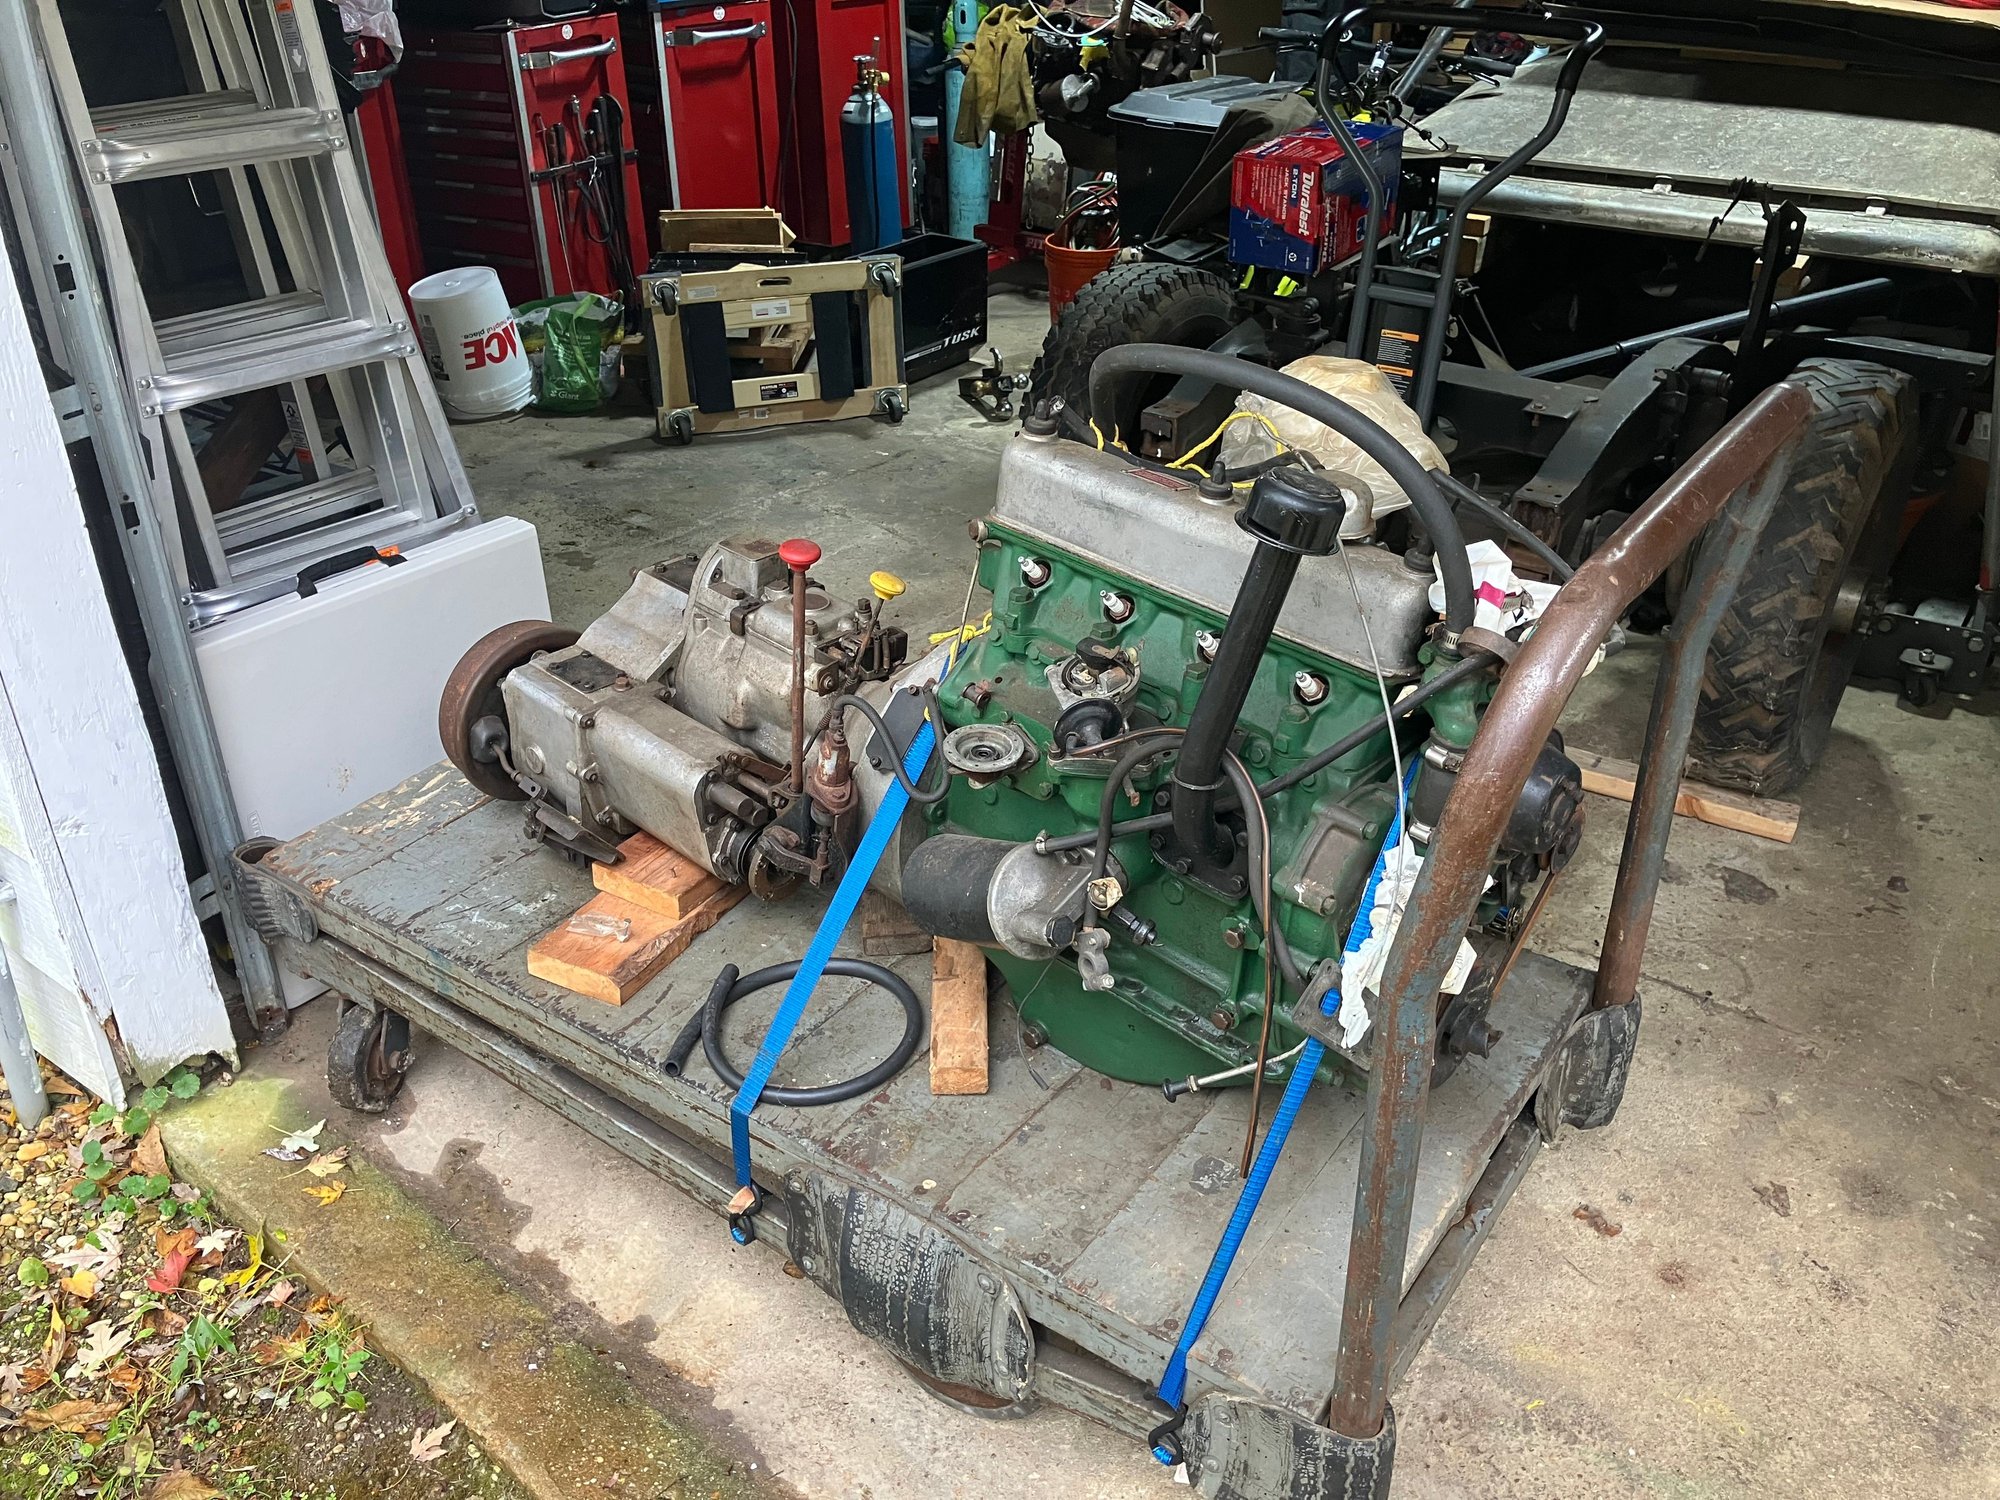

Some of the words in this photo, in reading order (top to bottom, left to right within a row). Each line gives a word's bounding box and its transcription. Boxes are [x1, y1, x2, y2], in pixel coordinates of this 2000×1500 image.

[1298, 171, 1315, 236] Duralast
[943, 326, 982, 349] TUSK
[558, 390, 580, 401] Giant
